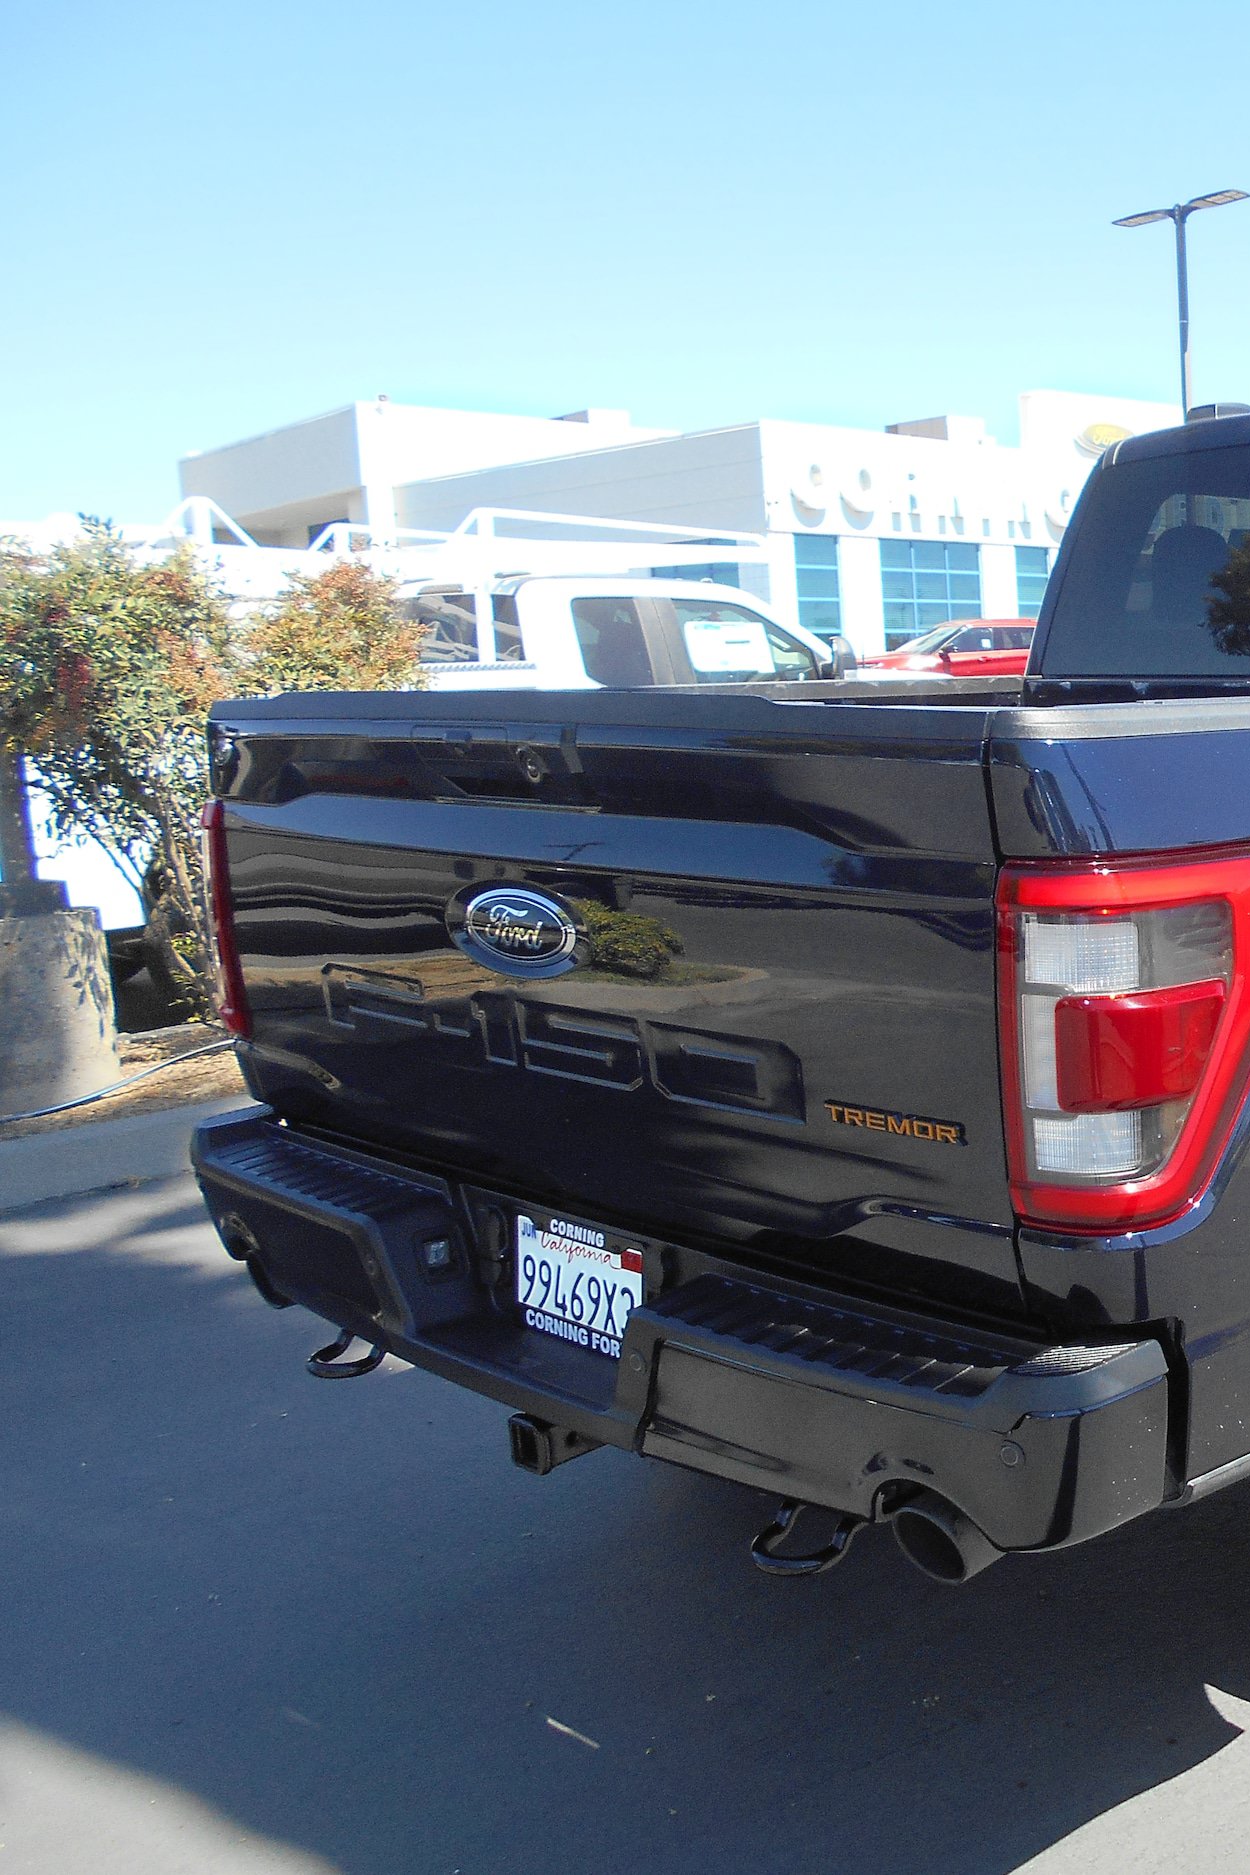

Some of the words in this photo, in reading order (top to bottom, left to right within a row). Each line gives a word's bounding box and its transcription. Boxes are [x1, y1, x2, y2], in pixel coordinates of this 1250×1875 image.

[486, 903, 543, 951] Ford
[824, 1101, 966, 1146] TREMOR
[541, 1231, 616, 1266] California
[550, 1217, 605, 1248] CORNING
[525, 1308, 589, 1346] CORNING
[592, 1332, 623, 1359] FOR
